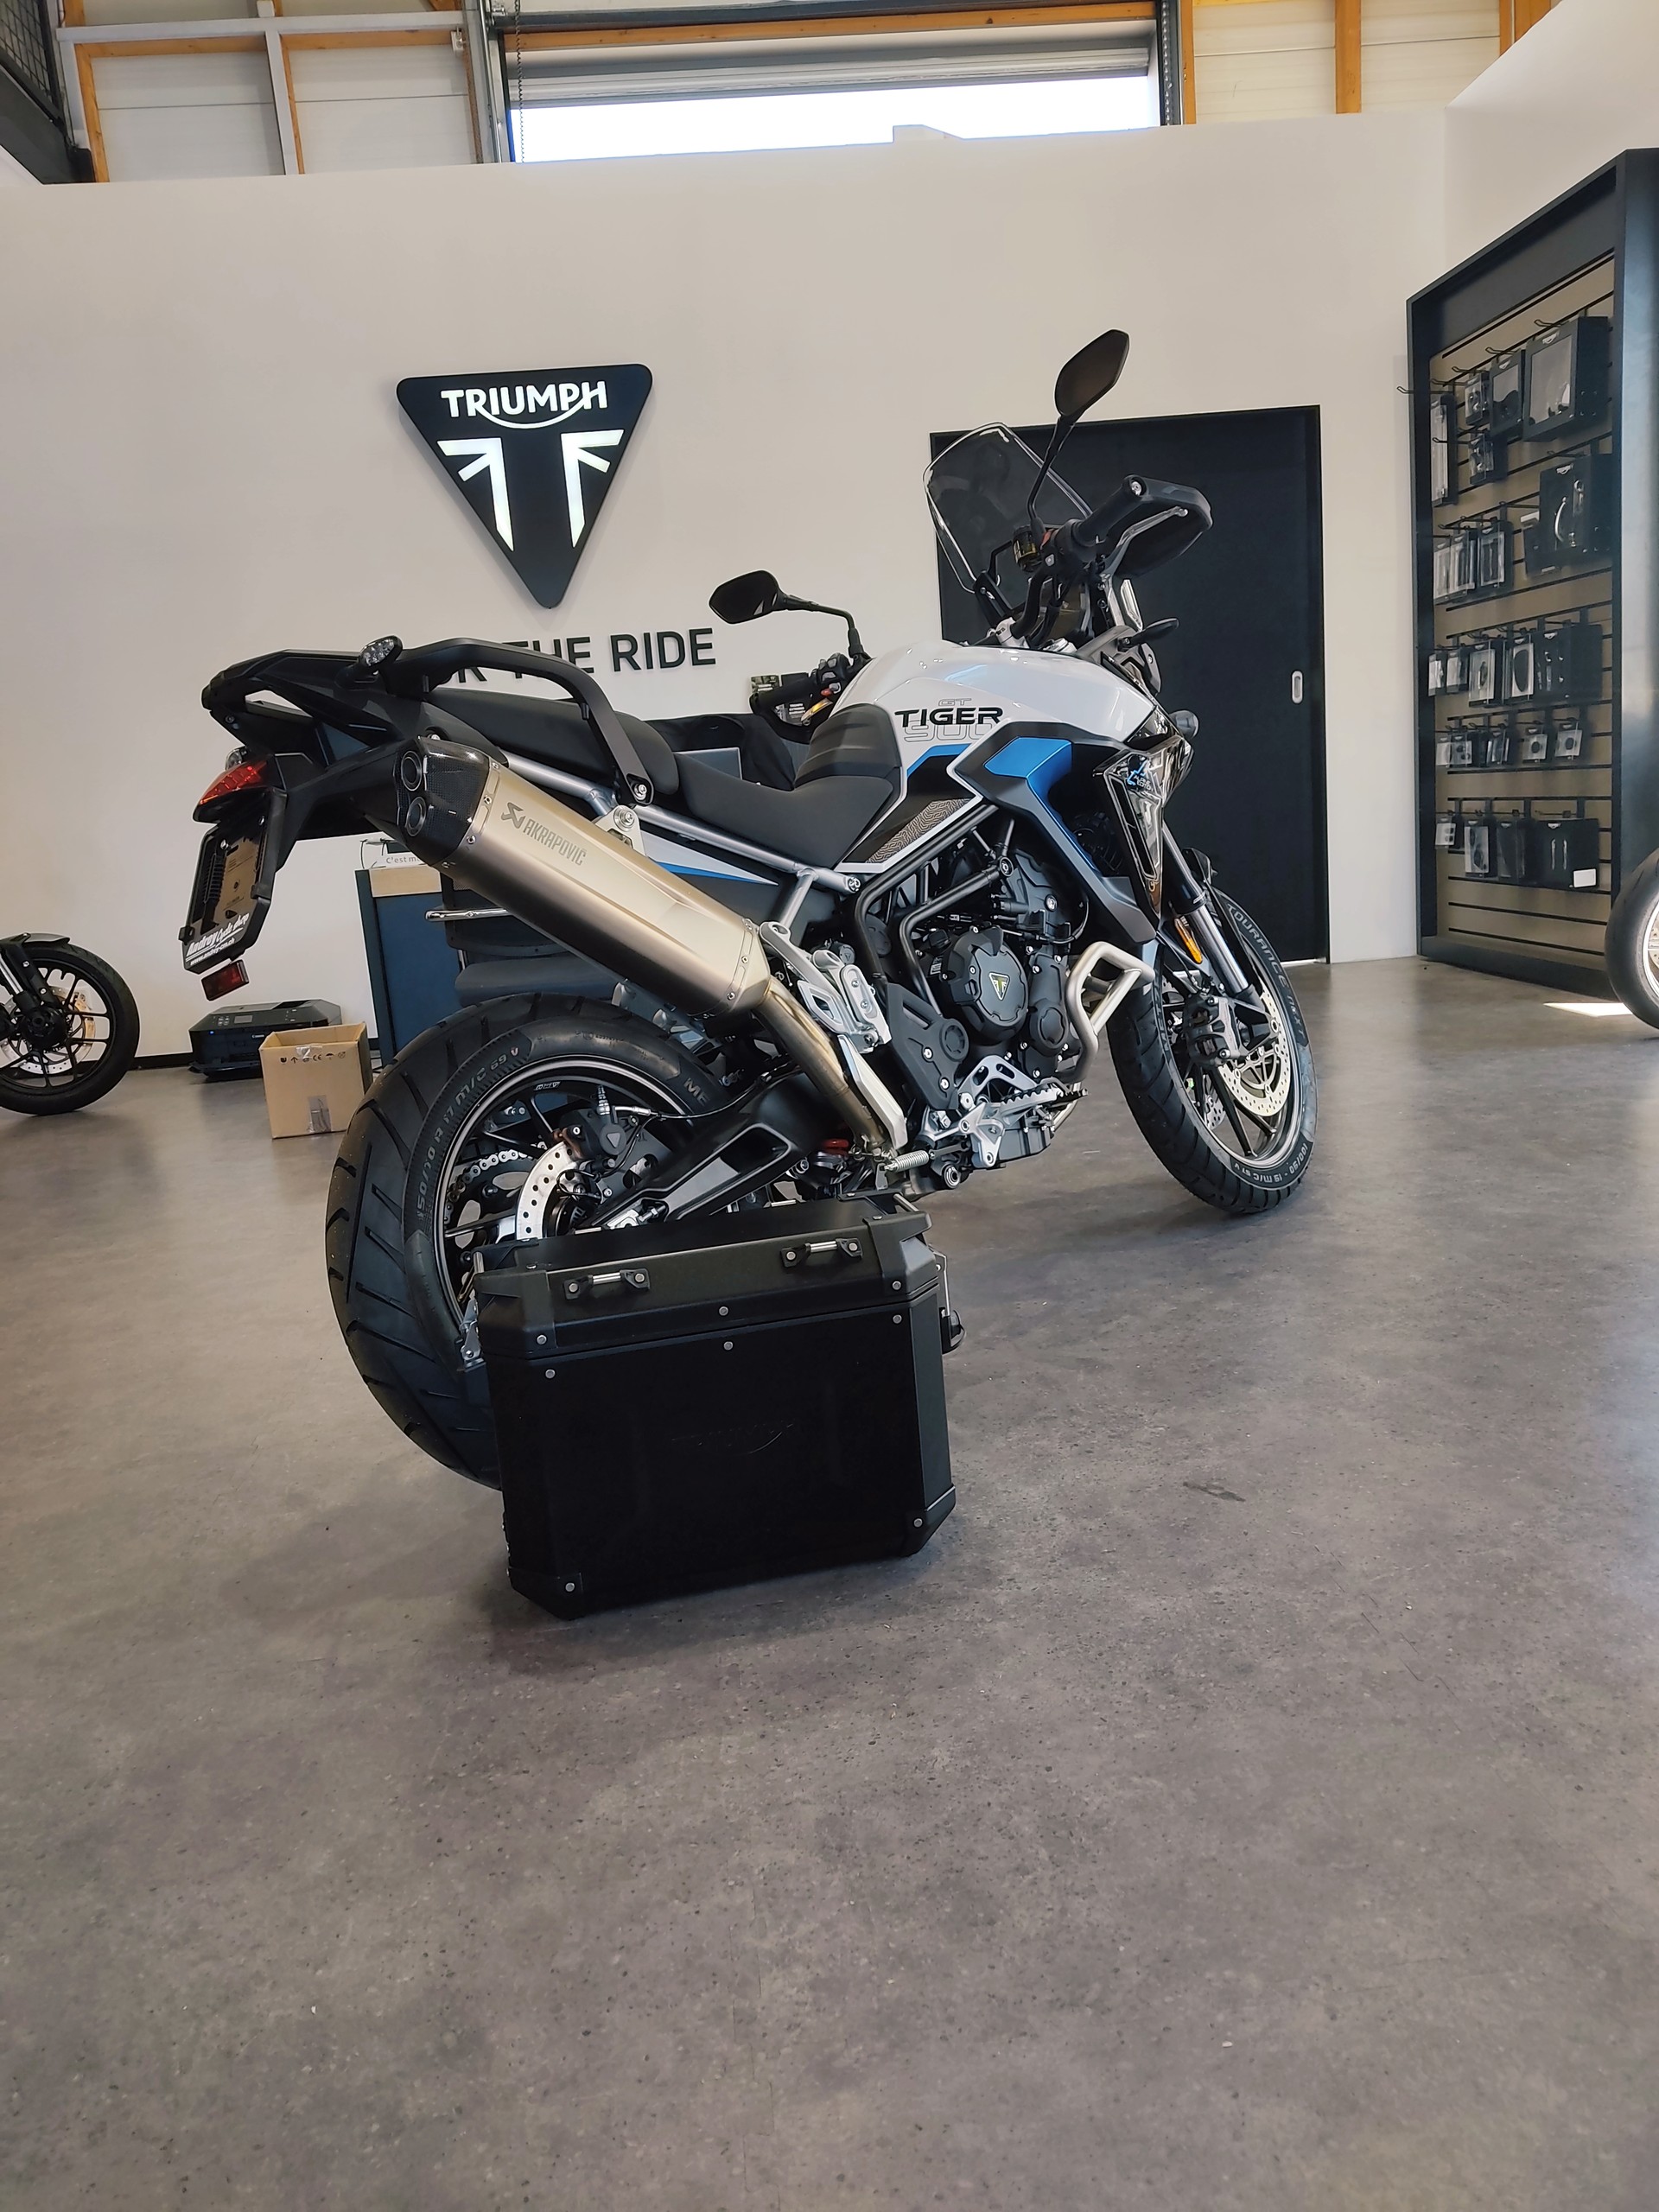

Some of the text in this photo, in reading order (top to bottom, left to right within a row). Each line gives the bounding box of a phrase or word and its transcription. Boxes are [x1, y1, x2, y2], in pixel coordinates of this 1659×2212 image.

[441, 380, 607, 429] TRIUMPH
[610, 627, 716, 672] RIDE
[894, 707, 1003, 728] TIGER
[1227, 903, 1289, 988] TOURANCE
[1288, 1142, 1308, 1174] 100/90
[1253, 1173, 1273, 1183] M/C
